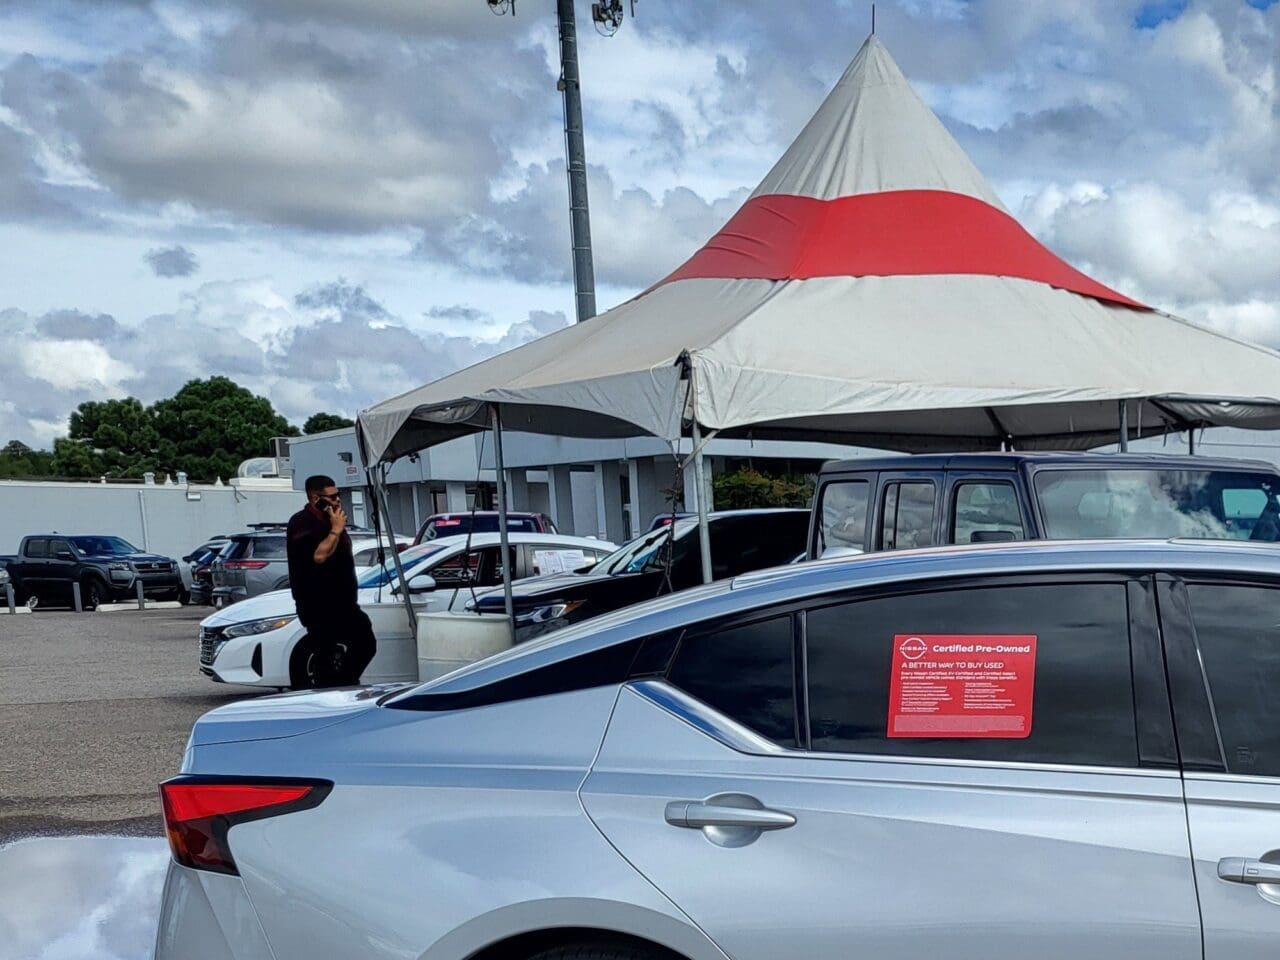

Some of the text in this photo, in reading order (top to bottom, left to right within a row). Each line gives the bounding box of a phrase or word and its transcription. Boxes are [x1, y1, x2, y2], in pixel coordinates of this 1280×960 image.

[932, 644, 1031, 653] Certified Pre-Owned
[908, 661, 938, 669] BETTER
[938, 661, 955, 669] WAY
[955, 661, 967, 669] TO
[967, 661, 983, 669] BUY
[983, 661, 1005, 669] USED
